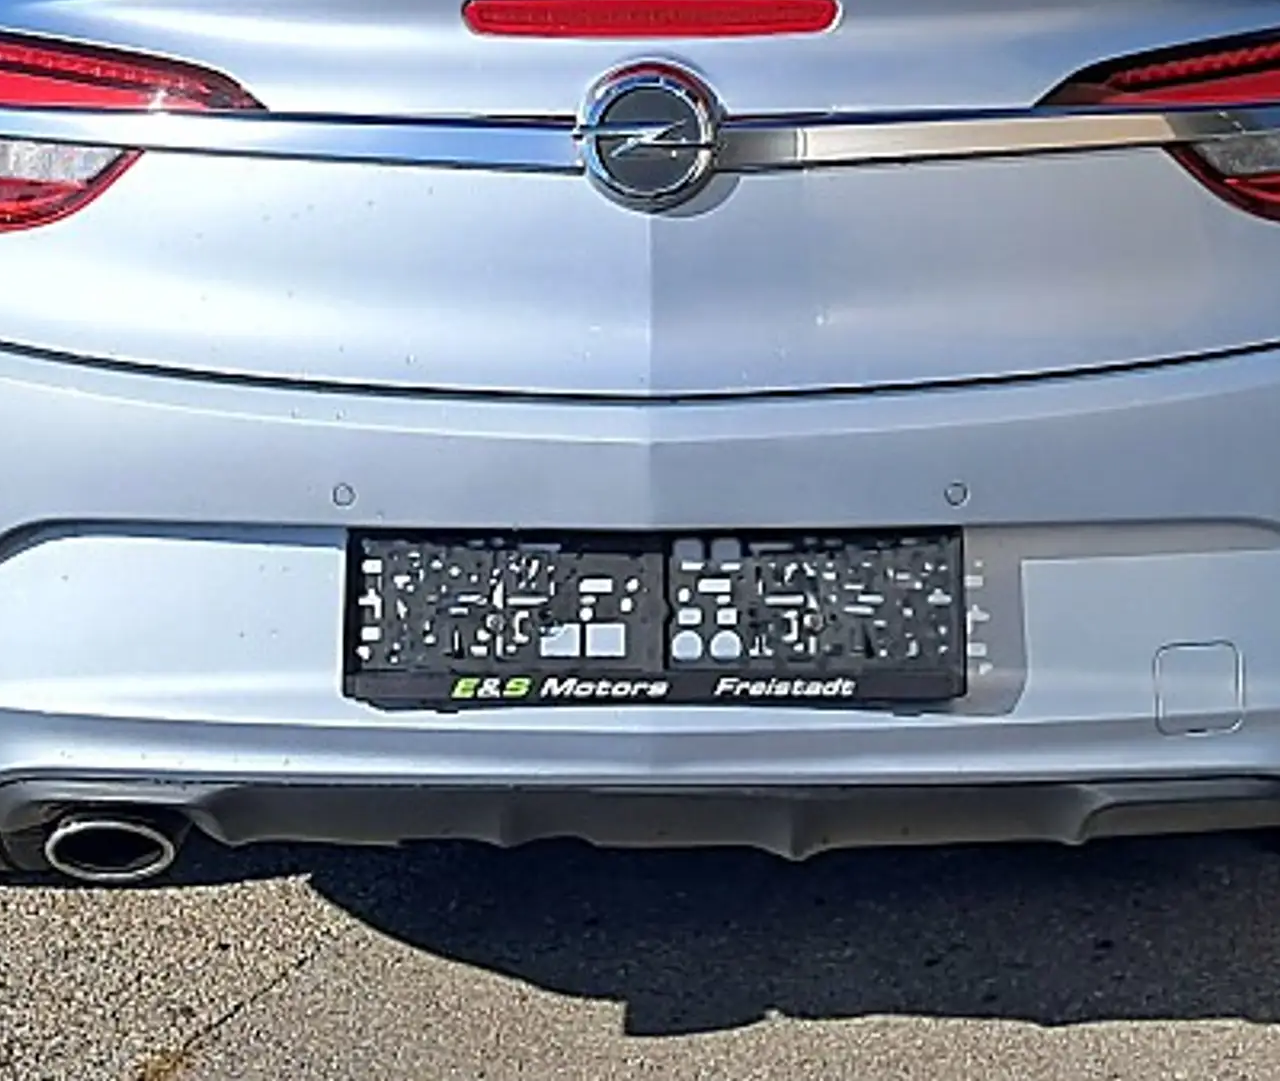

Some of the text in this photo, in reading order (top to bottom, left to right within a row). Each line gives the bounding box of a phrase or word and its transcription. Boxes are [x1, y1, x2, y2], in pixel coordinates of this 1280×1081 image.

[451, 676, 858, 698] E&S Motors Freistadt
